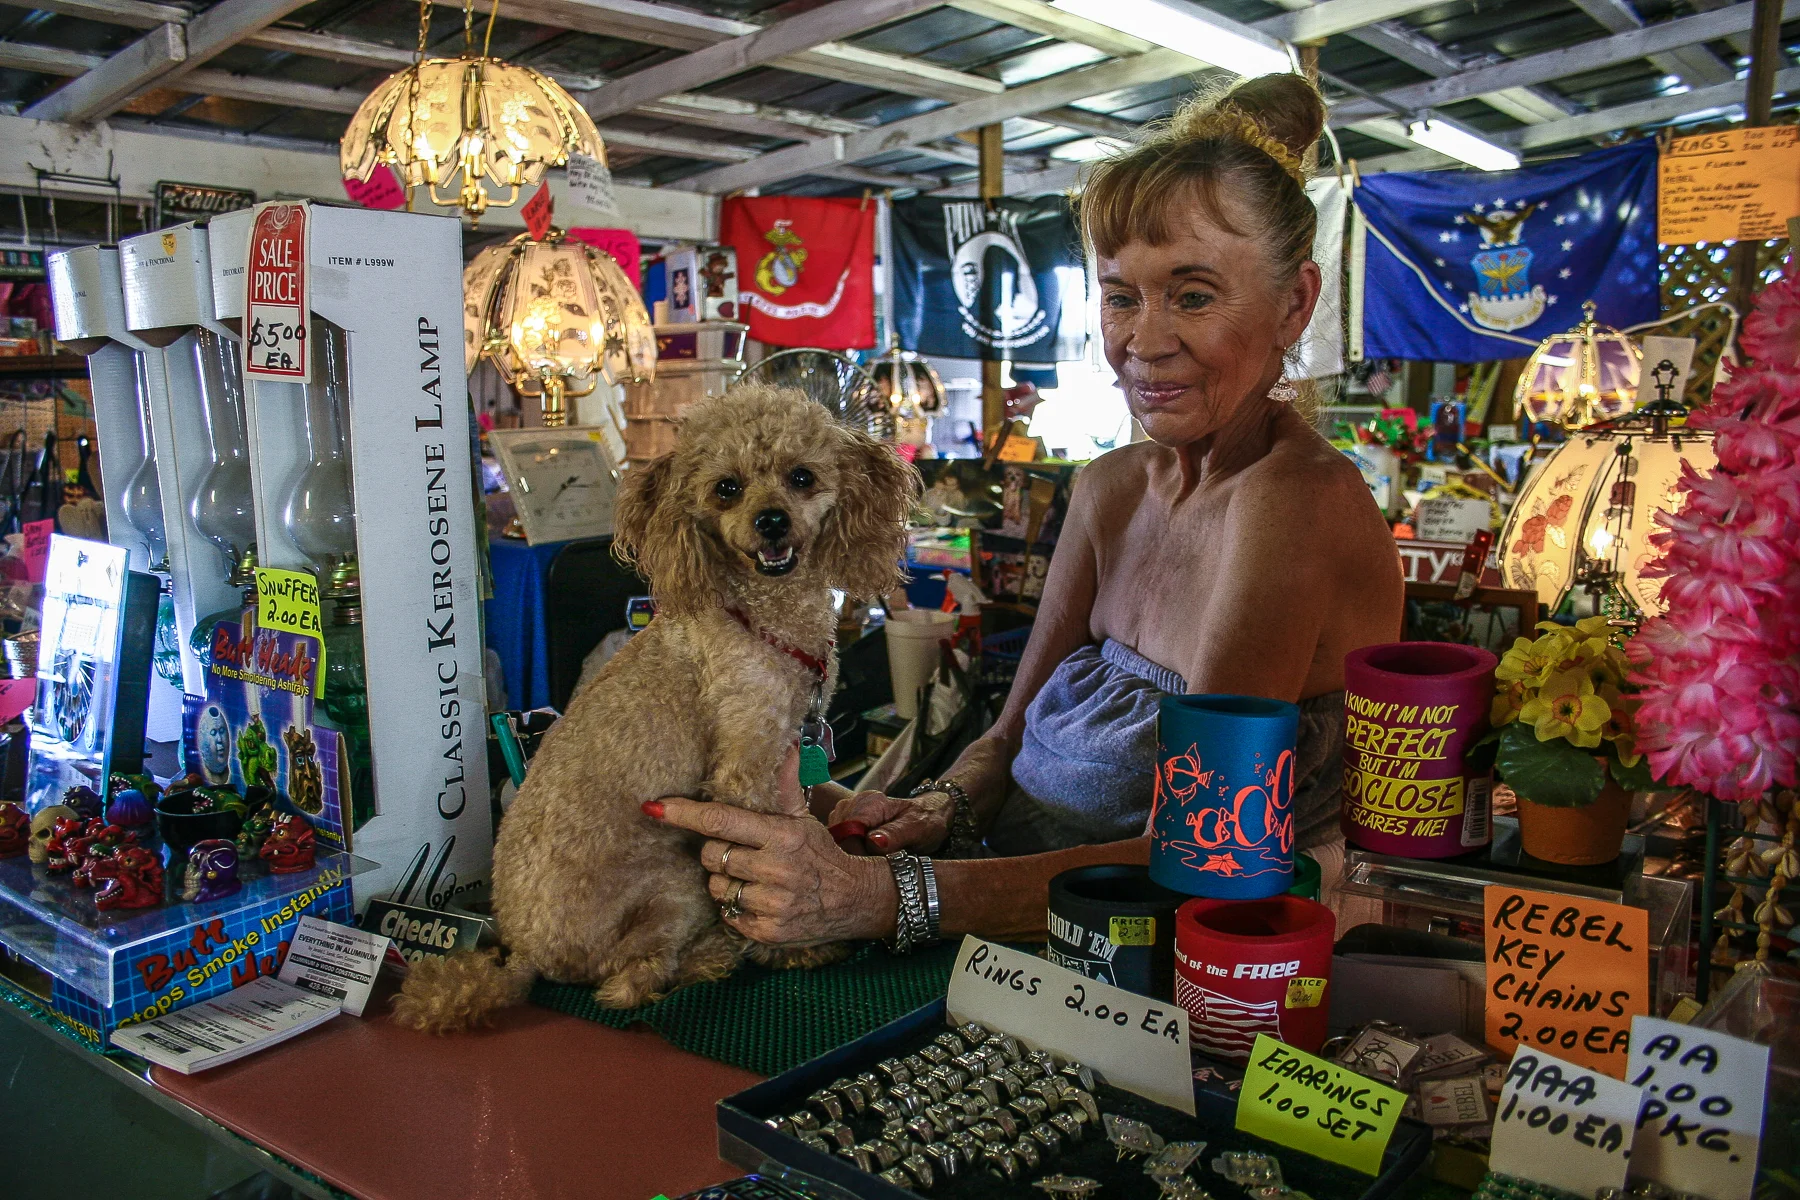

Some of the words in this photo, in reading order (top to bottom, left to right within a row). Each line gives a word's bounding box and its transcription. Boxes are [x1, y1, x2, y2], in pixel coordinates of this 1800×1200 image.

[222, 266, 245, 277] DECORATI
[259, 238, 293, 268] SALE
[328, 256, 352, 266] ITEM
[355, 257, 362, 266] #
[364, 256, 395, 267] L999W
[254, 271, 297, 302] PRICE
[248, 317, 307, 351] $5.00
[415, 316, 443, 432] LAMP
[425, 443, 456, 653] KEROSENE
[215, 628, 254, 669] Butt
[211, 663, 221, 675] No
[221, 664, 238, 679] More
[239, 668, 277, 691] Smoldering
[277, 679, 310, 697] Ashtrays
[1348, 692, 1386, 719] KNOW
[1384, 703, 1419, 724] I'M
[1419, 705, 1459, 725] NOT
[437, 659, 466, 821] CLASSIC
[1346, 715, 1457, 758] PERFECT
[1358, 753, 1387, 775] BUT
[1385, 759, 1421, 779] I'M
[1342, 767, 1362, 798] SO
[1364, 777, 1461, 814] CLOSE
[1351, 806, 1409, 836] SCARES
[1411, 819, 1449, 837] ME!
[187, 929, 260, 988] Smoke
[260, 863, 345, 934] Instantly
[380, 909, 458, 949] Checks
[1050, 911, 1084, 947] HOLD
[1111, 918, 1150, 926] PRICE
[1492, 894, 1633, 952] REBEL
[136, 912, 230, 993] Butt
[298, 934, 334, 951] EVERYTHING
[343, 947, 378, 962] ALUMINUM
[1493, 934, 1565, 981] KEY
[320, 963, 335, 973] WOOD
[335, 967, 371, 982] CONSTRUCTION
[1189, 959, 1202, 970] of
[1206, 964, 1228, 977] the
[1290, 979, 1322, 987] PRICE
[1065, 984, 1128, 1026] 2.00
[1420, 1048, 1473, 1071] EBEL
[1643, 1034, 1718, 1075] AA
[1504, 1055, 1597, 1106] AAA
[1631, 1065, 1733, 1116] 1.00
[1258, 1082, 1310, 1119] 1.00
[1317, 1107, 1377, 1141] SET
[1454, 1082, 1480, 1121] REBEL
